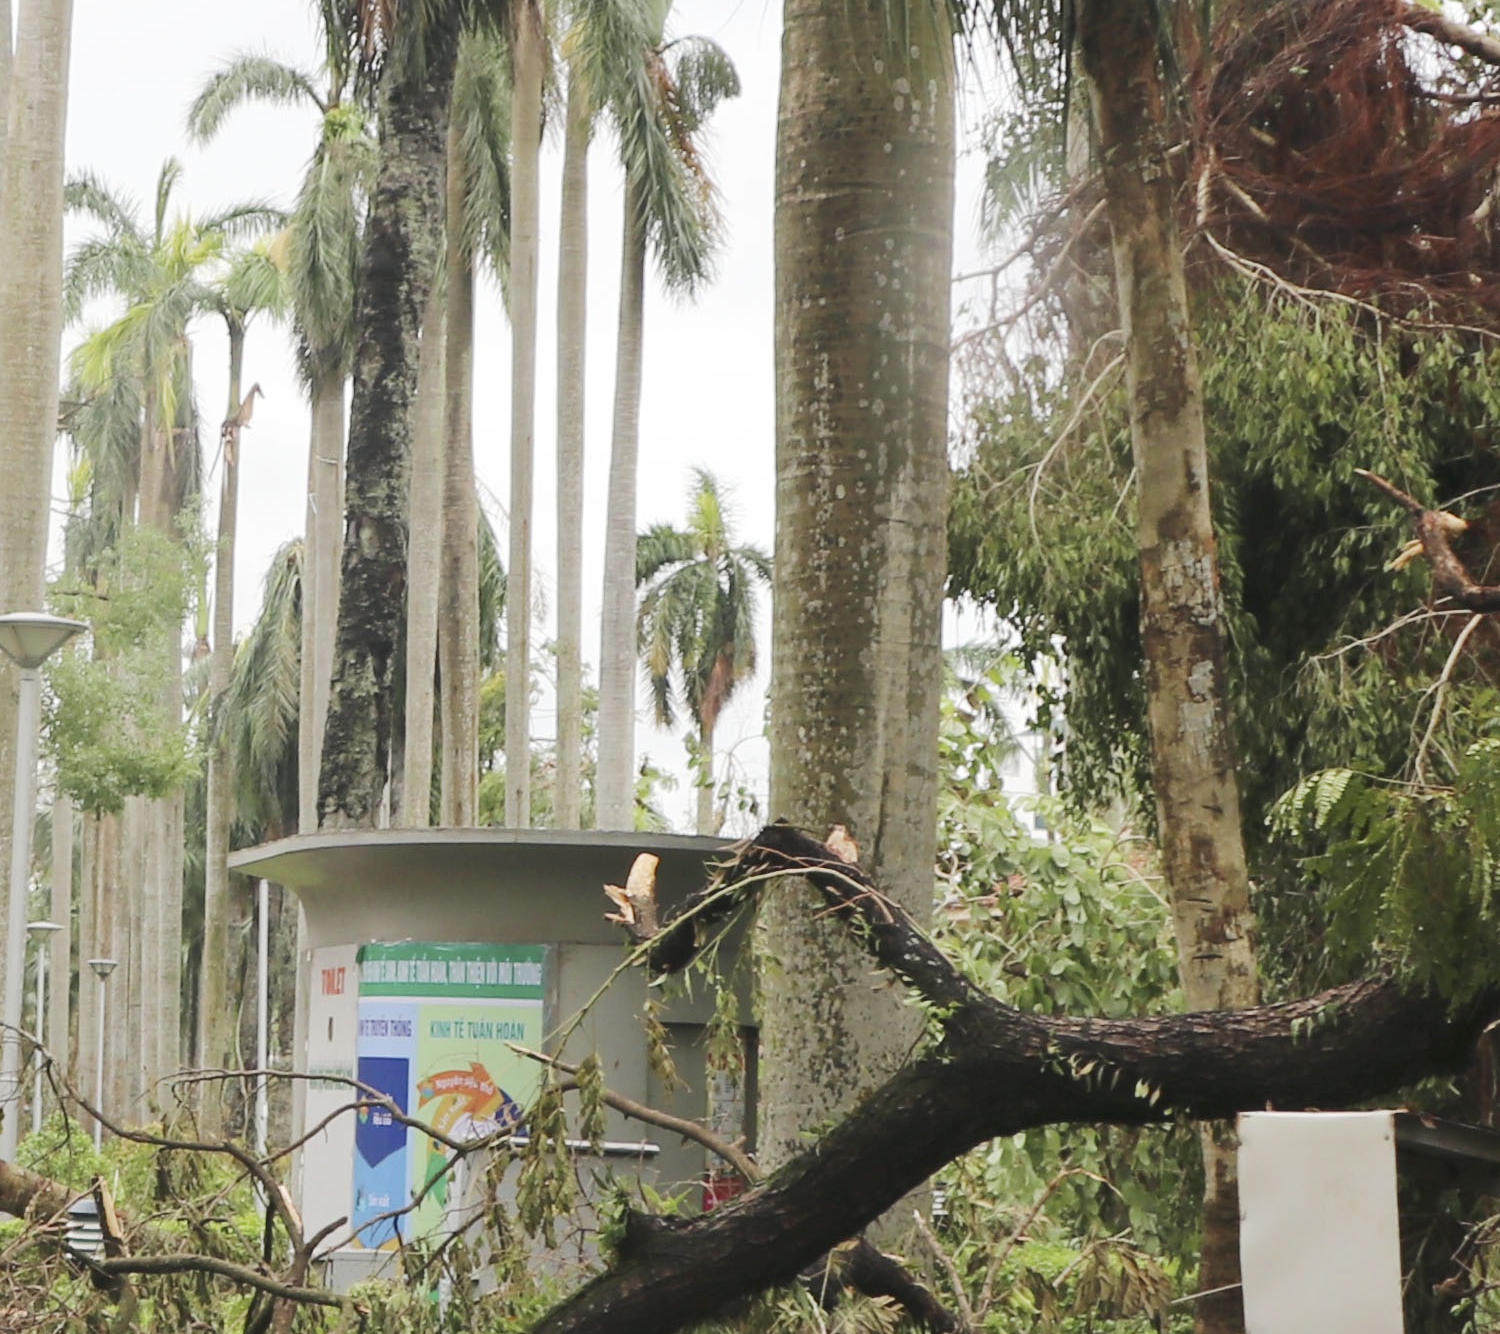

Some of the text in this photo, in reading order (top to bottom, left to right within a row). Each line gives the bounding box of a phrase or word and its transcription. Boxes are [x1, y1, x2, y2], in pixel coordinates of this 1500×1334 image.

[430, 1019, 451, 1039] KINH
[454, 1015, 465, 1040] TẾ
[496, 1017, 525, 1041] HOÀN
